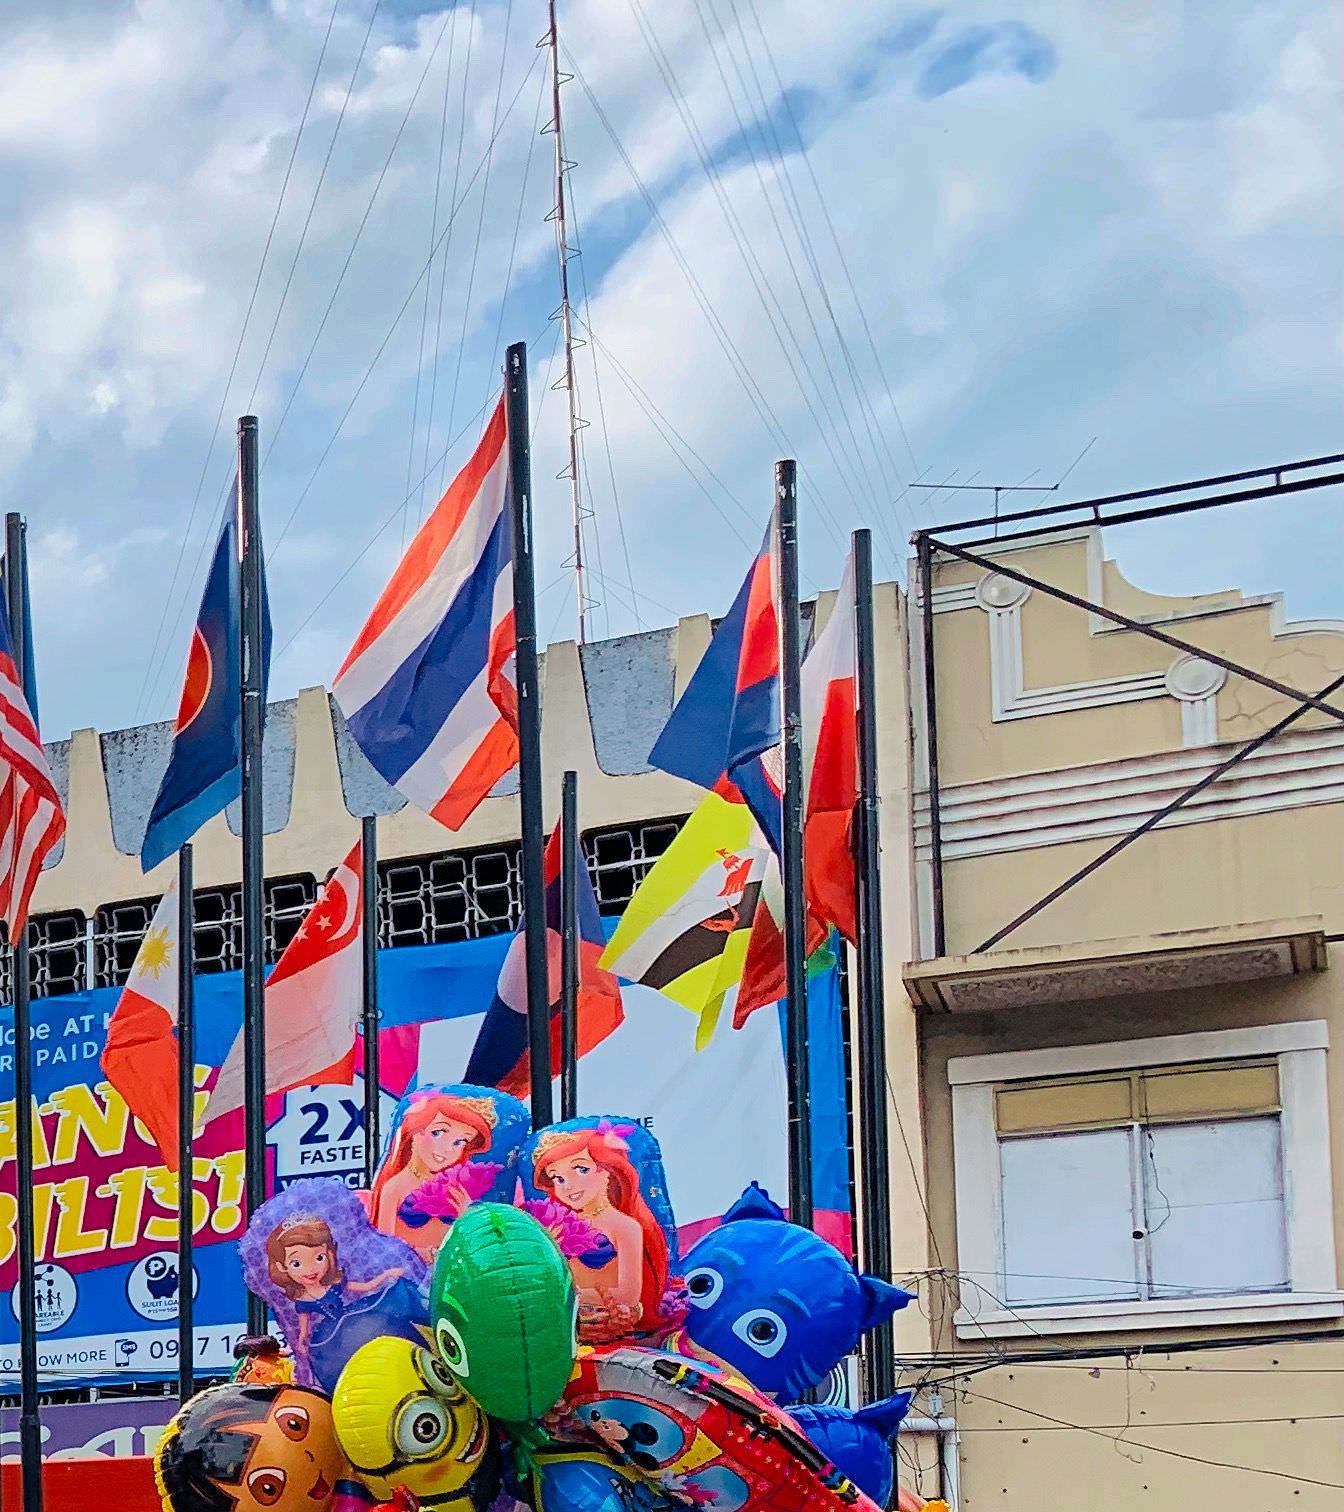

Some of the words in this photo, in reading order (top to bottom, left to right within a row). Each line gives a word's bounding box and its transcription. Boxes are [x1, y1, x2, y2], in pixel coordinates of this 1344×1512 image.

[64, 1014, 95, 1037] AT
[300, 1145, 363, 1165] FASTE
[66, 1350, 107, 1364] MORE
